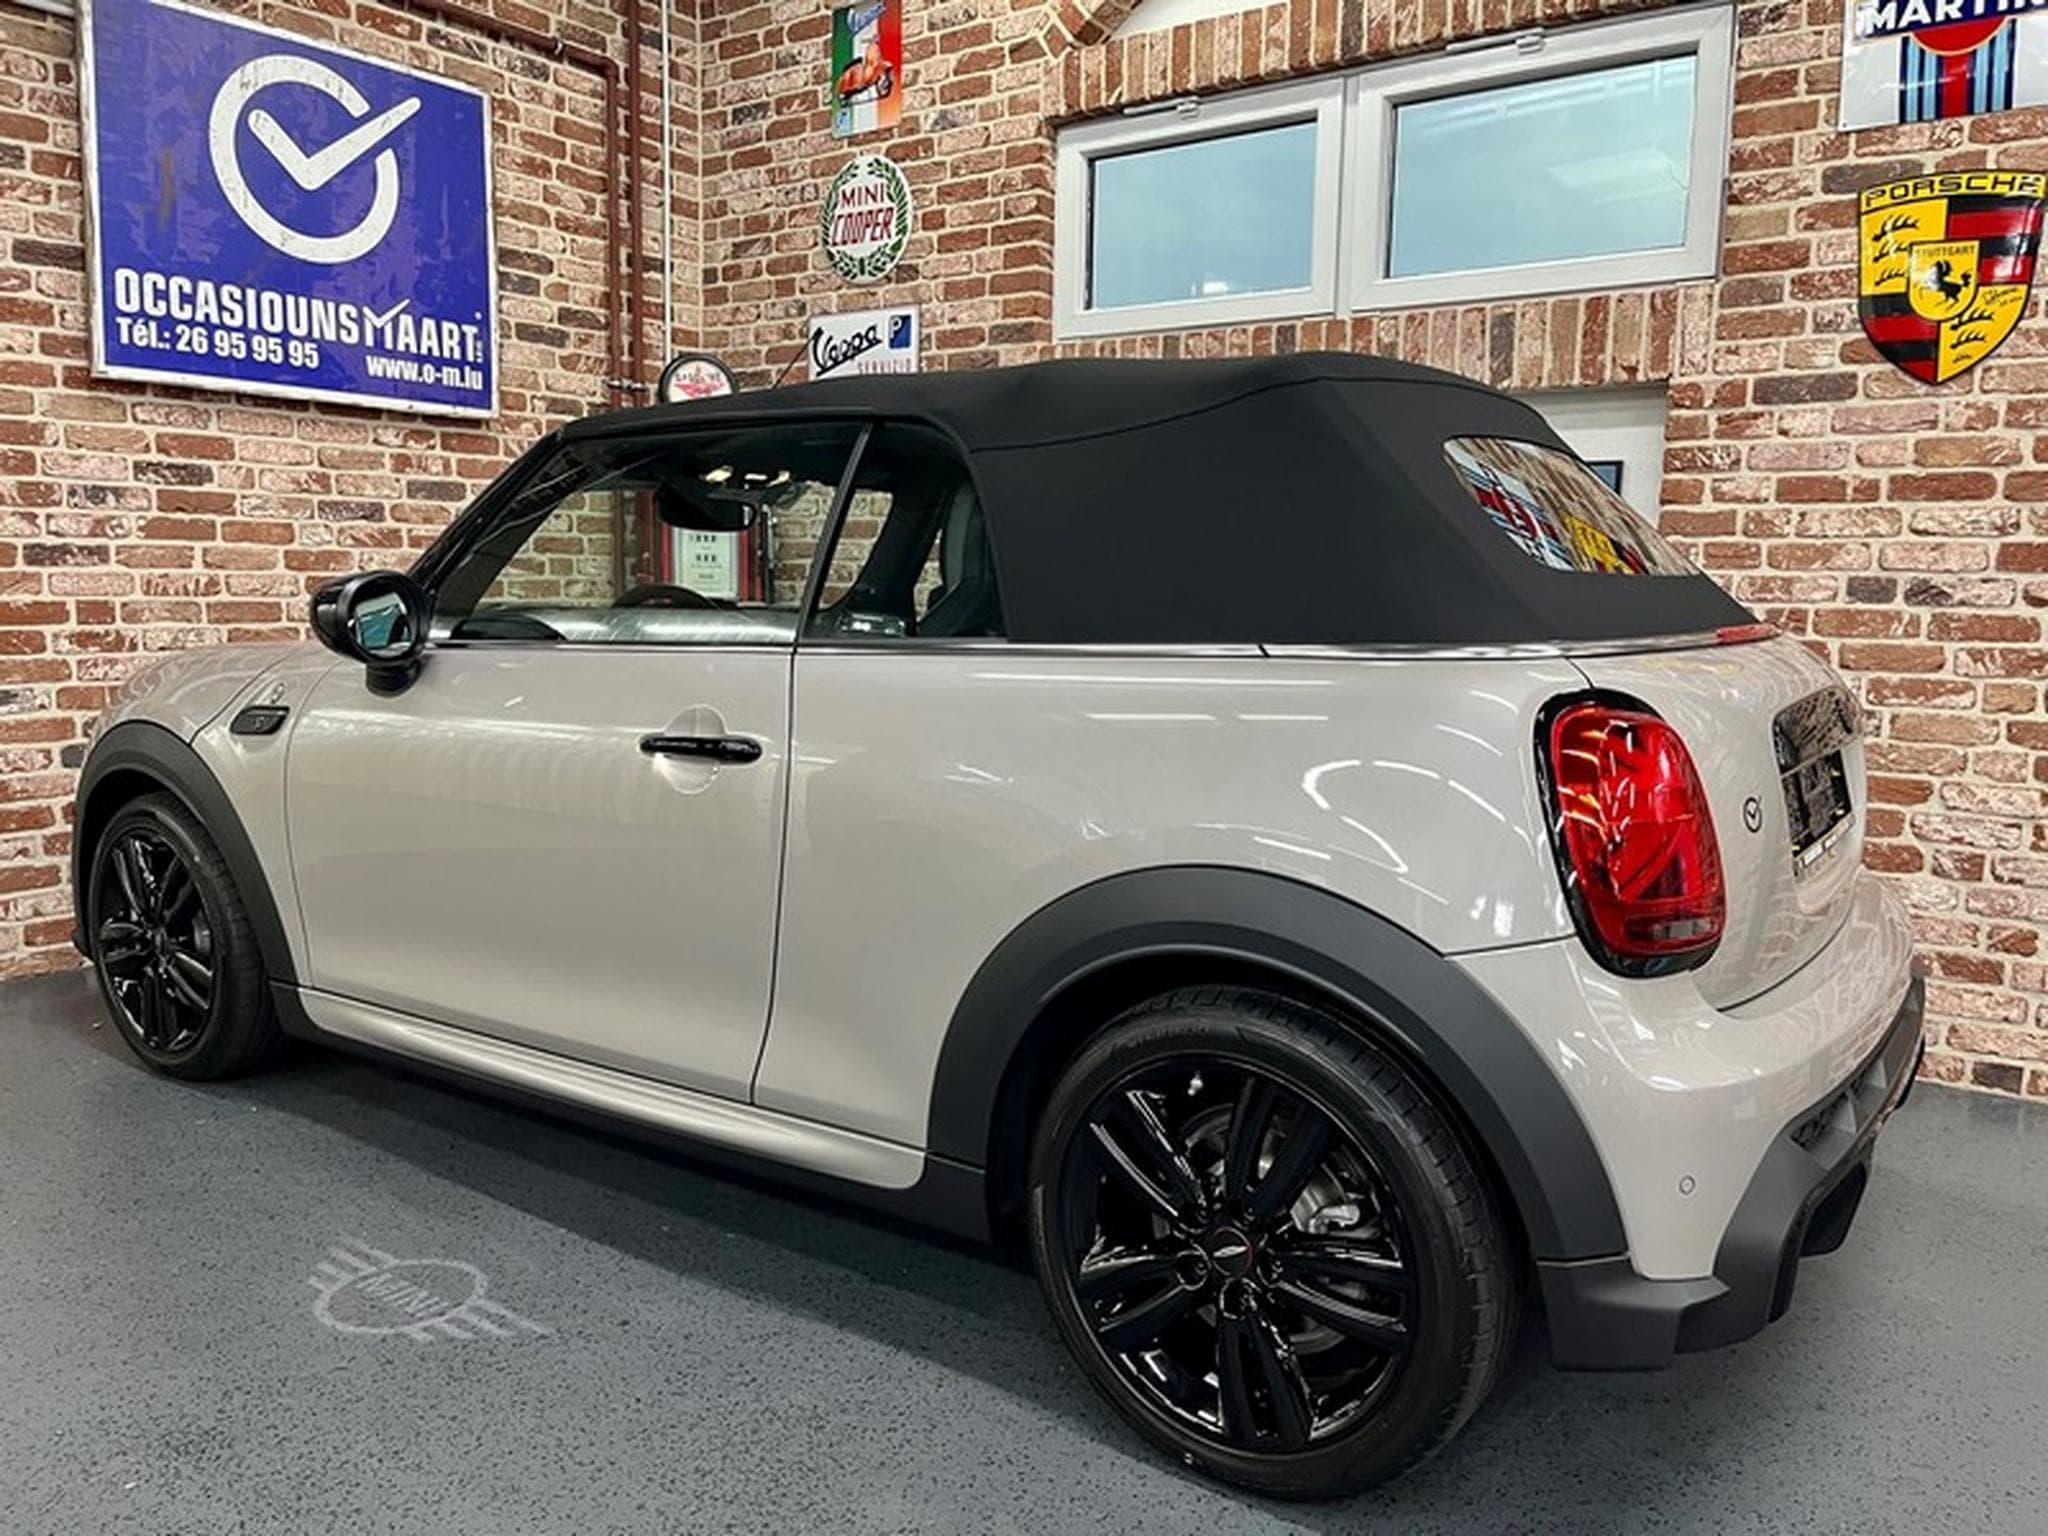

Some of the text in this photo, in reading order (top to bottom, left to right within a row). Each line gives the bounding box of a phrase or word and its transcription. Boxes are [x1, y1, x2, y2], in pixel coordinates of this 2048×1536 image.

[841, 183, 884, 208] MINI
[1865, 174, 2040, 207] PORSCHE
[832, 207, 894, 246] COOPER
[116, 317, 319, 369] Tél.: 26 95 95 95
[812, 324, 883, 377] Vespa
[365, 355, 483, 390] www.o-m.lu
